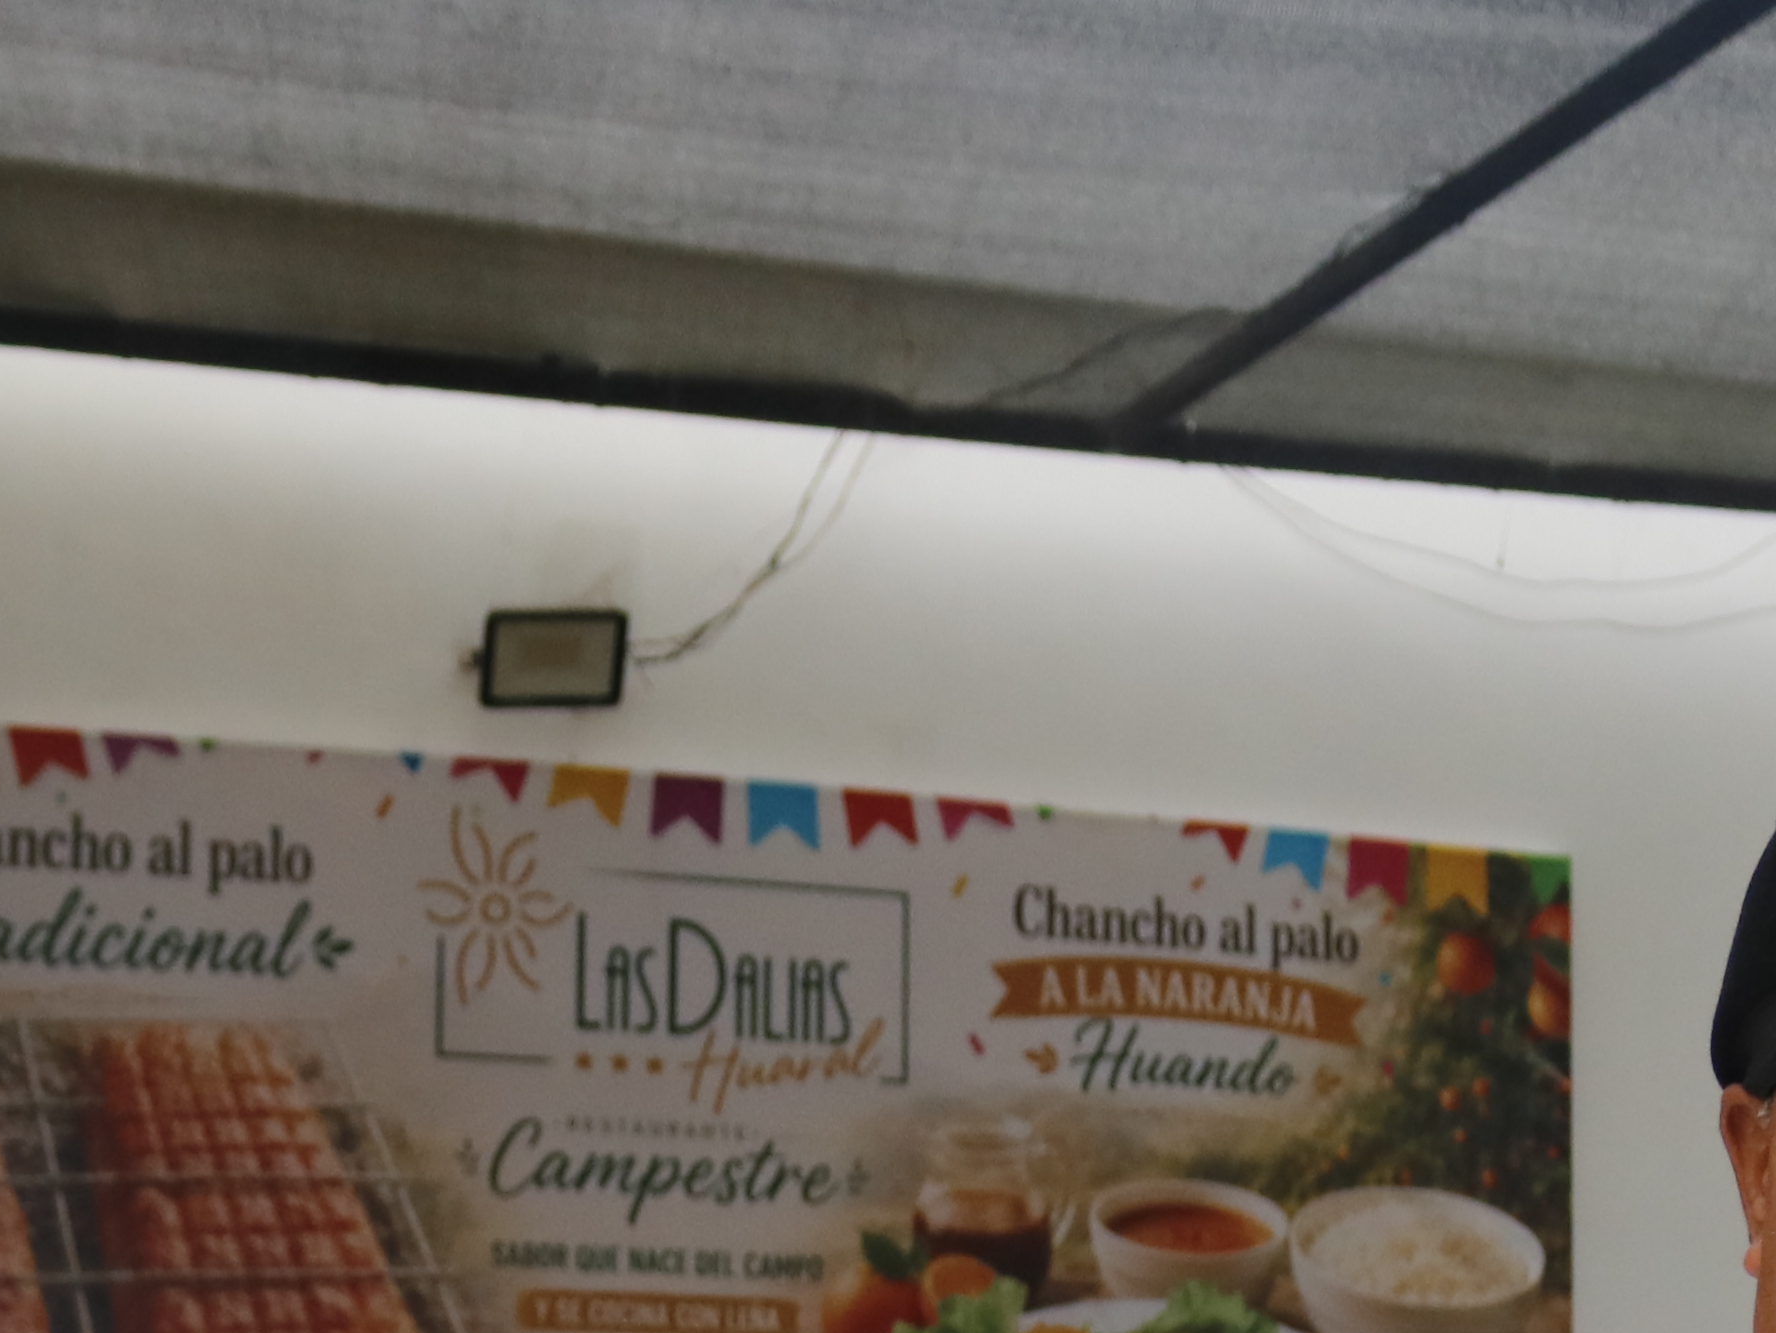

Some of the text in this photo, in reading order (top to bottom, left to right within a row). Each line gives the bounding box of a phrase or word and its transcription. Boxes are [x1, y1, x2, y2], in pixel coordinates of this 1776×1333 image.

[148, 817, 191, 877] al
[209, 826, 314, 893] palo
[1013, 884, 1360, 970] Chancho al palo
[1040, 965, 1316, 1031] A LA NARANJA
[682, 1017, 885, 1114] Huaral
[1070, 1016, 1294, 1096] Huando
[488, 1115, 837, 1225] Campestre
[491, 1239, 825, 1282] SABOR QUE NACE DEL CAMPO
